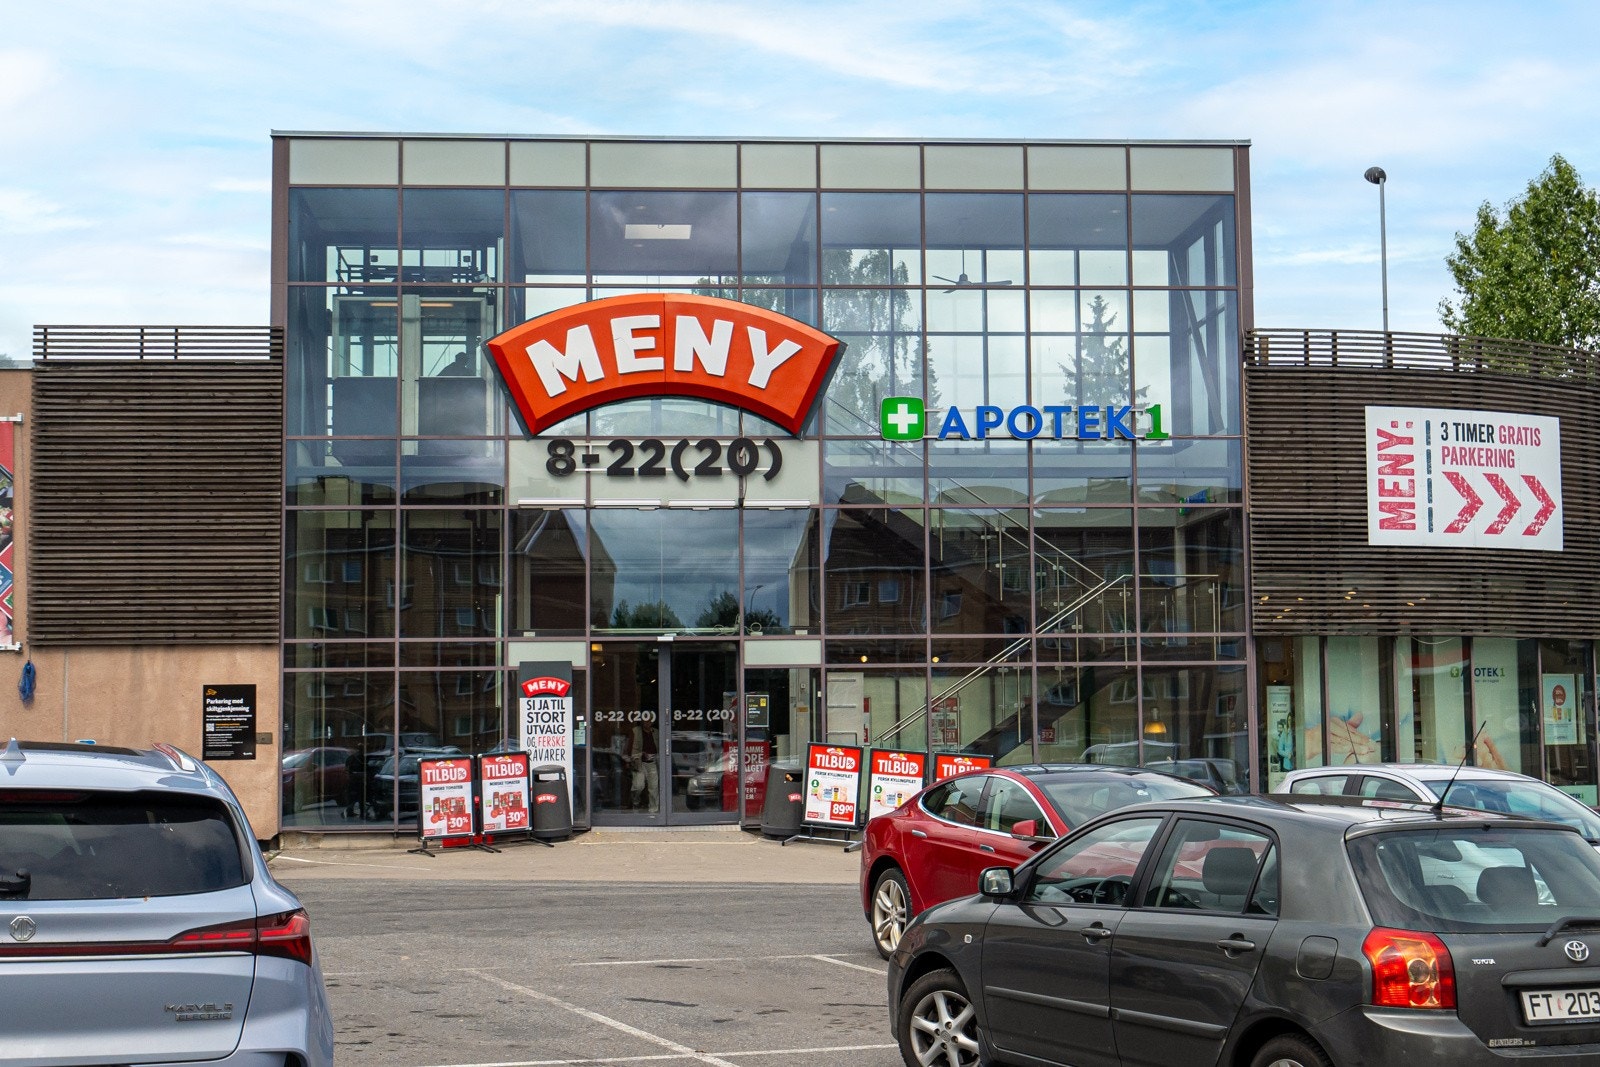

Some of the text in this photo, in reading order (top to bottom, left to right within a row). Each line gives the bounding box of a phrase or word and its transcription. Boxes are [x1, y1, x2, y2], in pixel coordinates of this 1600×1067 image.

[525, 314, 803, 397] MENY
[937, 404, 1169, 440] APOTEK 1
[1441, 421, 1541, 447] 3 TIMER GRATIS
[1441, 446, 1515, 468] PARKERING
[527, 680, 565, 693] MENY
[527, 700, 565, 710] SI JA TIL
[527, 712, 566, 723] STORT
[594, 710, 656, 723] 8-22 (20)
[674, 710, 704, 721] 8-22
[706, 710, 735, 722] (20)
[527, 724, 566, 734] UTVALG
[527, 736, 566, 748] OG FERSKE
[815, 754, 856, 770] TILBUD
[878, 759, 918, 774] TILBUD
[424, 767, 467, 782] TILBUD
[485, 762, 524, 778] TILBUD
[164, 1004, 223, 1012] MARVEL
[1528, 992, 1600, 1017] FT 203
[177, 1012, 232, 1021] ELECTRIC
